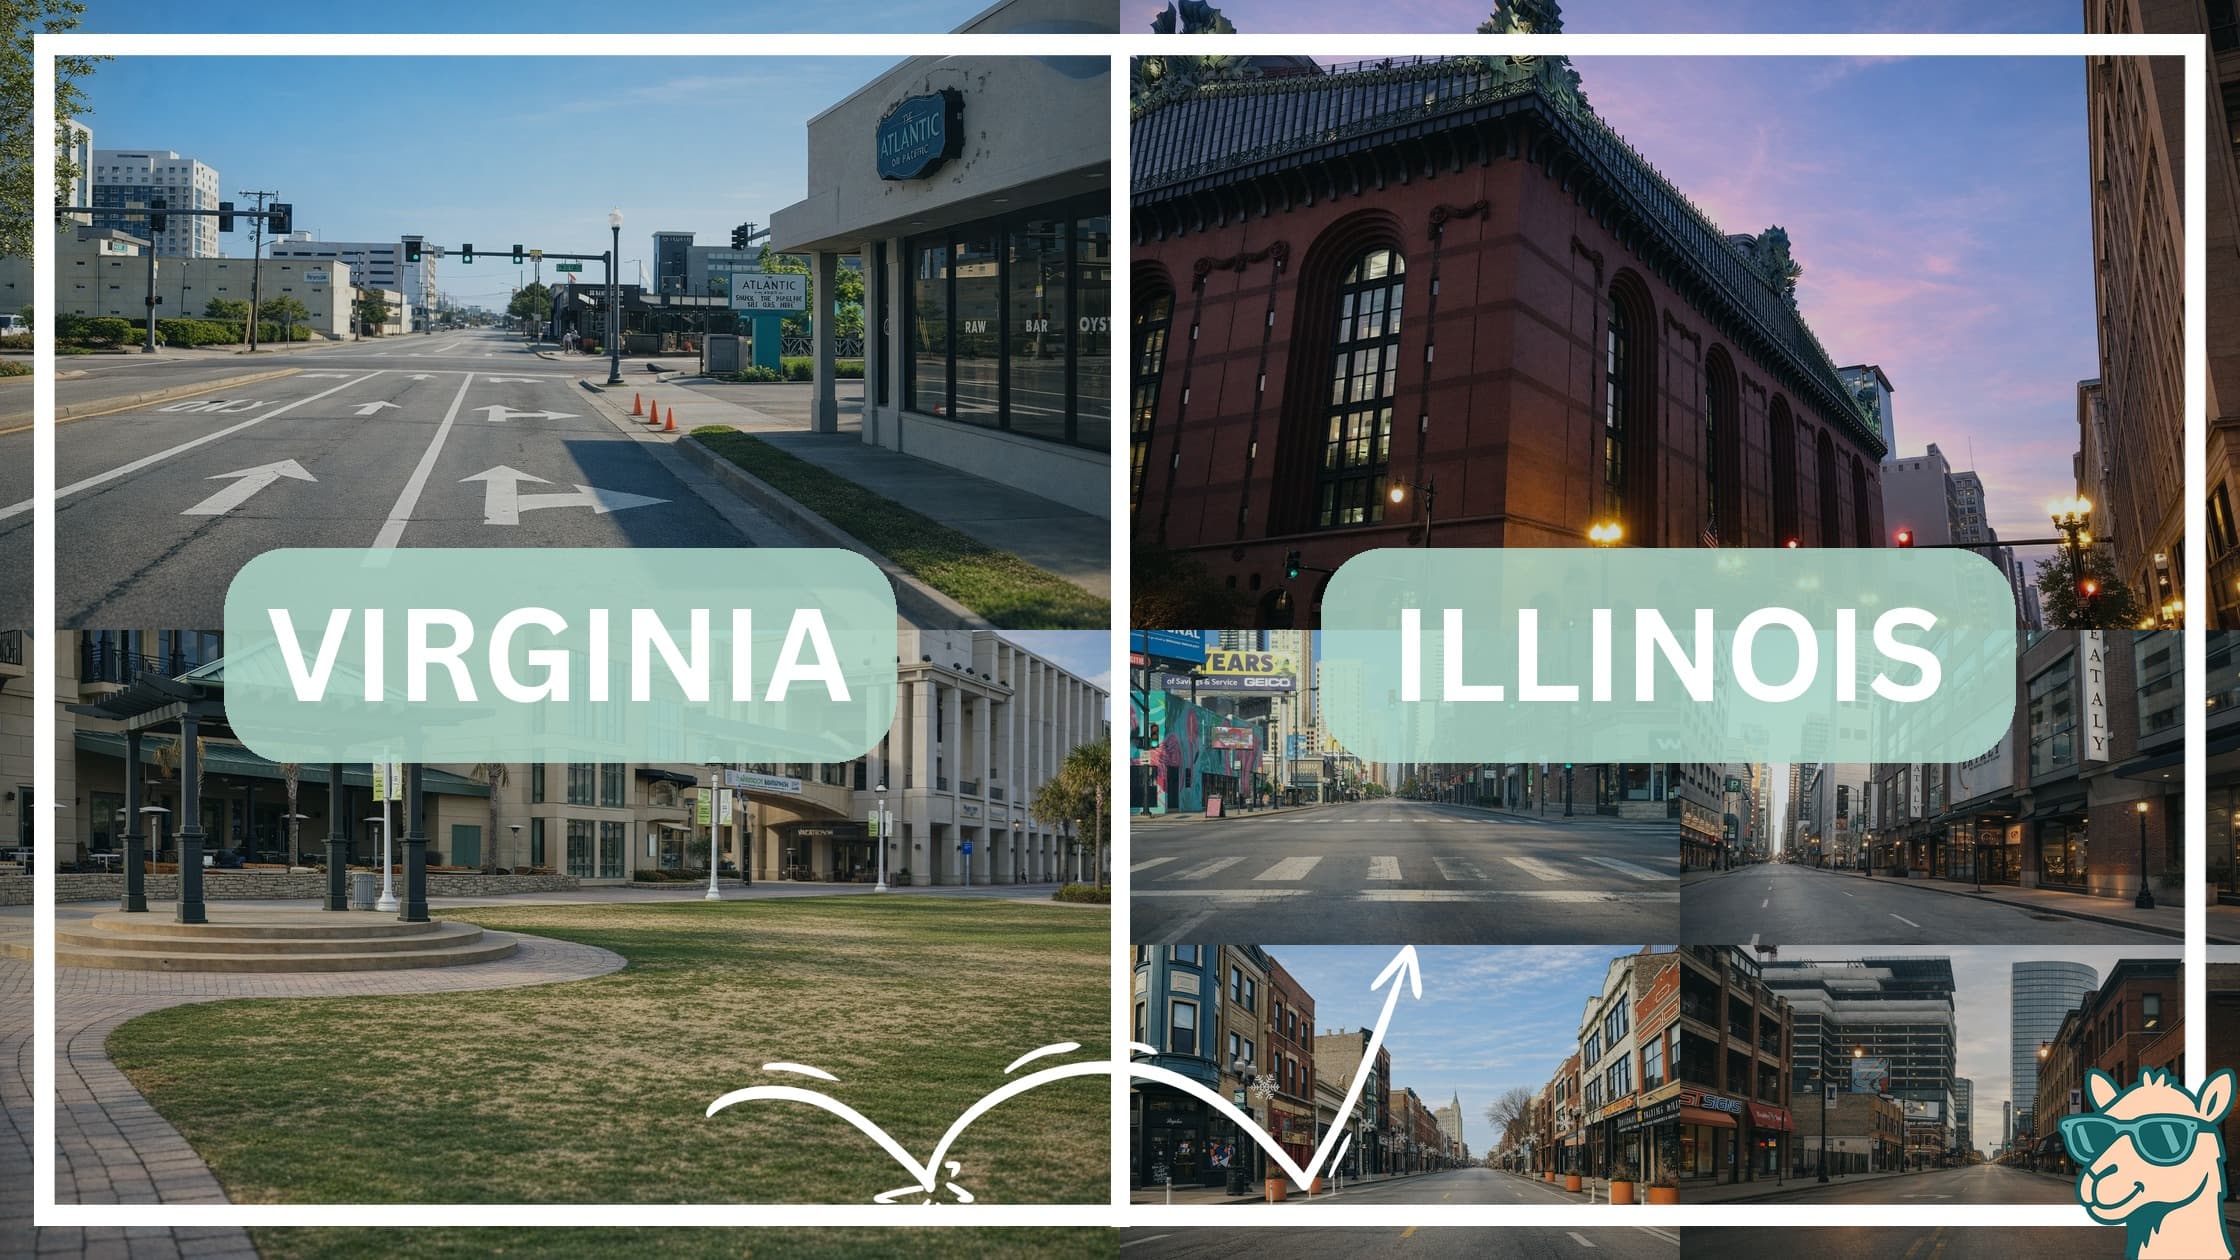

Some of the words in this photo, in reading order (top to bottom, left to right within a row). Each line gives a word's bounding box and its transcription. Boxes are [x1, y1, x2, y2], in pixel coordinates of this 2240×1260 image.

[880, 112, 940, 158] ATLANTIC
[742, 280, 797, 291] ATLANTIC
[965, 320, 986, 333] RAW
[1026, 319, 1048, 333] BAR
[1212, 679, 1238, 687] Service
[1244, 677, 1291, 687] GEICO
[2089, 630, 2104, 751] EATALY
